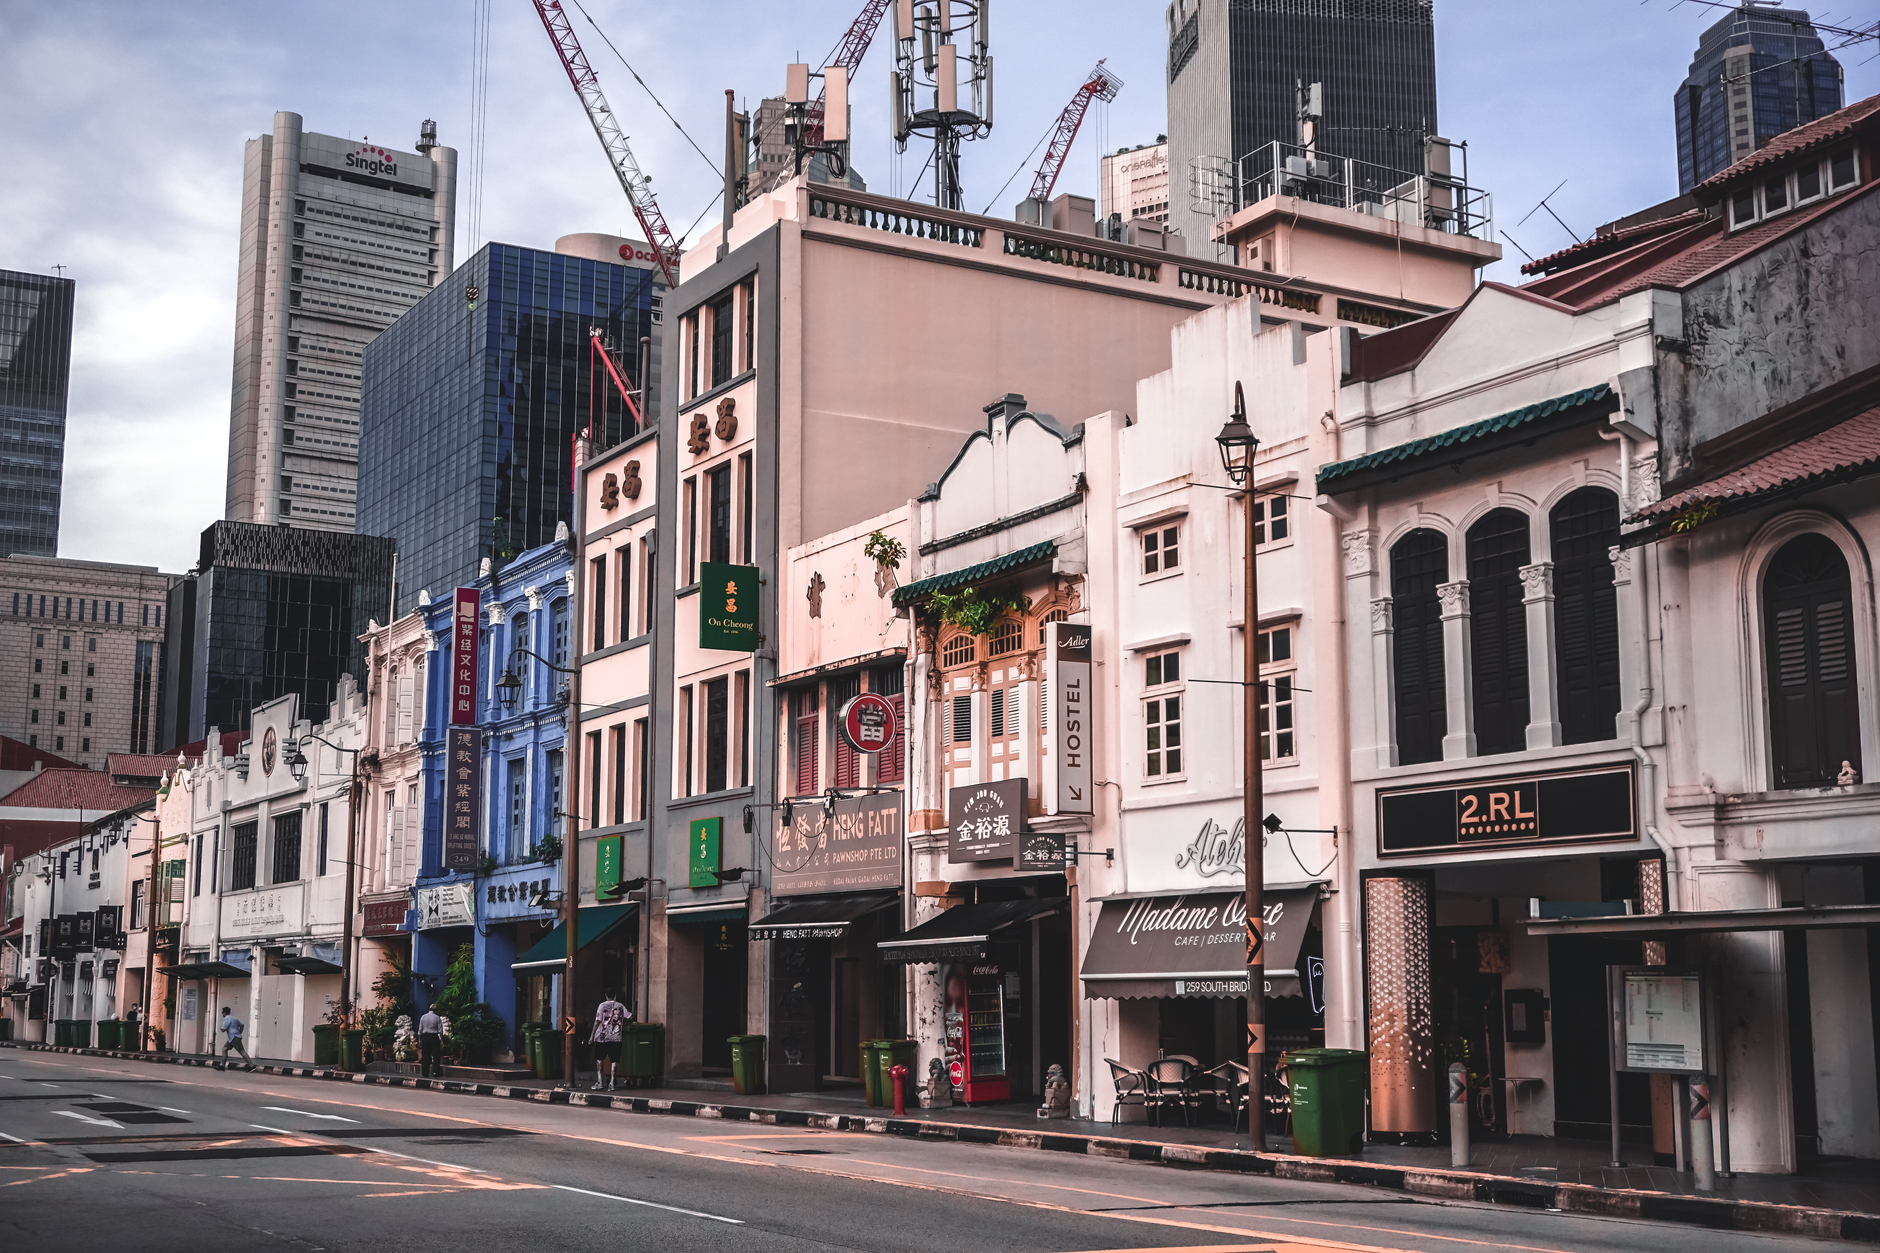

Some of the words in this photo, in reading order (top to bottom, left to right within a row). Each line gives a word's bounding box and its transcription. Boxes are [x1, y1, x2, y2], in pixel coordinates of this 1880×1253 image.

[345, 152, 397, 176] Singtel
[635, 250, 660, 263] OCB
[708, 617, 721, 626] On
[723, 619, 753, 631] Cheong
[1058, 635, 1090, 649] Adler
[458, 624, 473, 711] 紫经文化中心
[857, 702, 887, 743] 當
[1066, 678, 1081, 768] HOSTEL
[455, 732, 473, 829] 德教會紫經閣
[963, 797, 974, 813] KIM
[976, 789, 987, 800] JOO
[989, 790, 1004, 808] GUAN
[1460, 790, 1535, 825] 2.RL
[833, 811, 864, 841] HENG
[868, 807, 897, 837] FATT
[956, 814, 1011, 842] 金裕源
[454, 855, 469, 863] 249
[832, 850, 868, 864] PAWNSHOP
[870, 847, 882, 860] PTE
[884, 846, 897, 859] LTD
[1022, 849, 1064, 860] 金裕源
[1175, 816, 1268, 878] Ateli
[833, 877, 844, 885] KEDAI
[845, 876, 857, 884] PAJAK
[857, 875, 871, 884] GADAI
[871, 874, 883, 882] HENG
[883, 873, 894, 881] FATT
[1117, 895, 1218, 945] Madame
[782, 929, 797, 939] HENG
[798, 929, 811, 938] FATT
[811, 927, 843, 938] PAWNSHOP
[1174, 936, 1199, 946] CAFE
[1207, 932, 1246, 945] DESSERT
[1261, 932, 1277, 942] AR
[1186, 981, 1200, 992] 259
[1201, 981, 1228, 992] SOUTH
[1229, 981, 1250, 992] BRID
